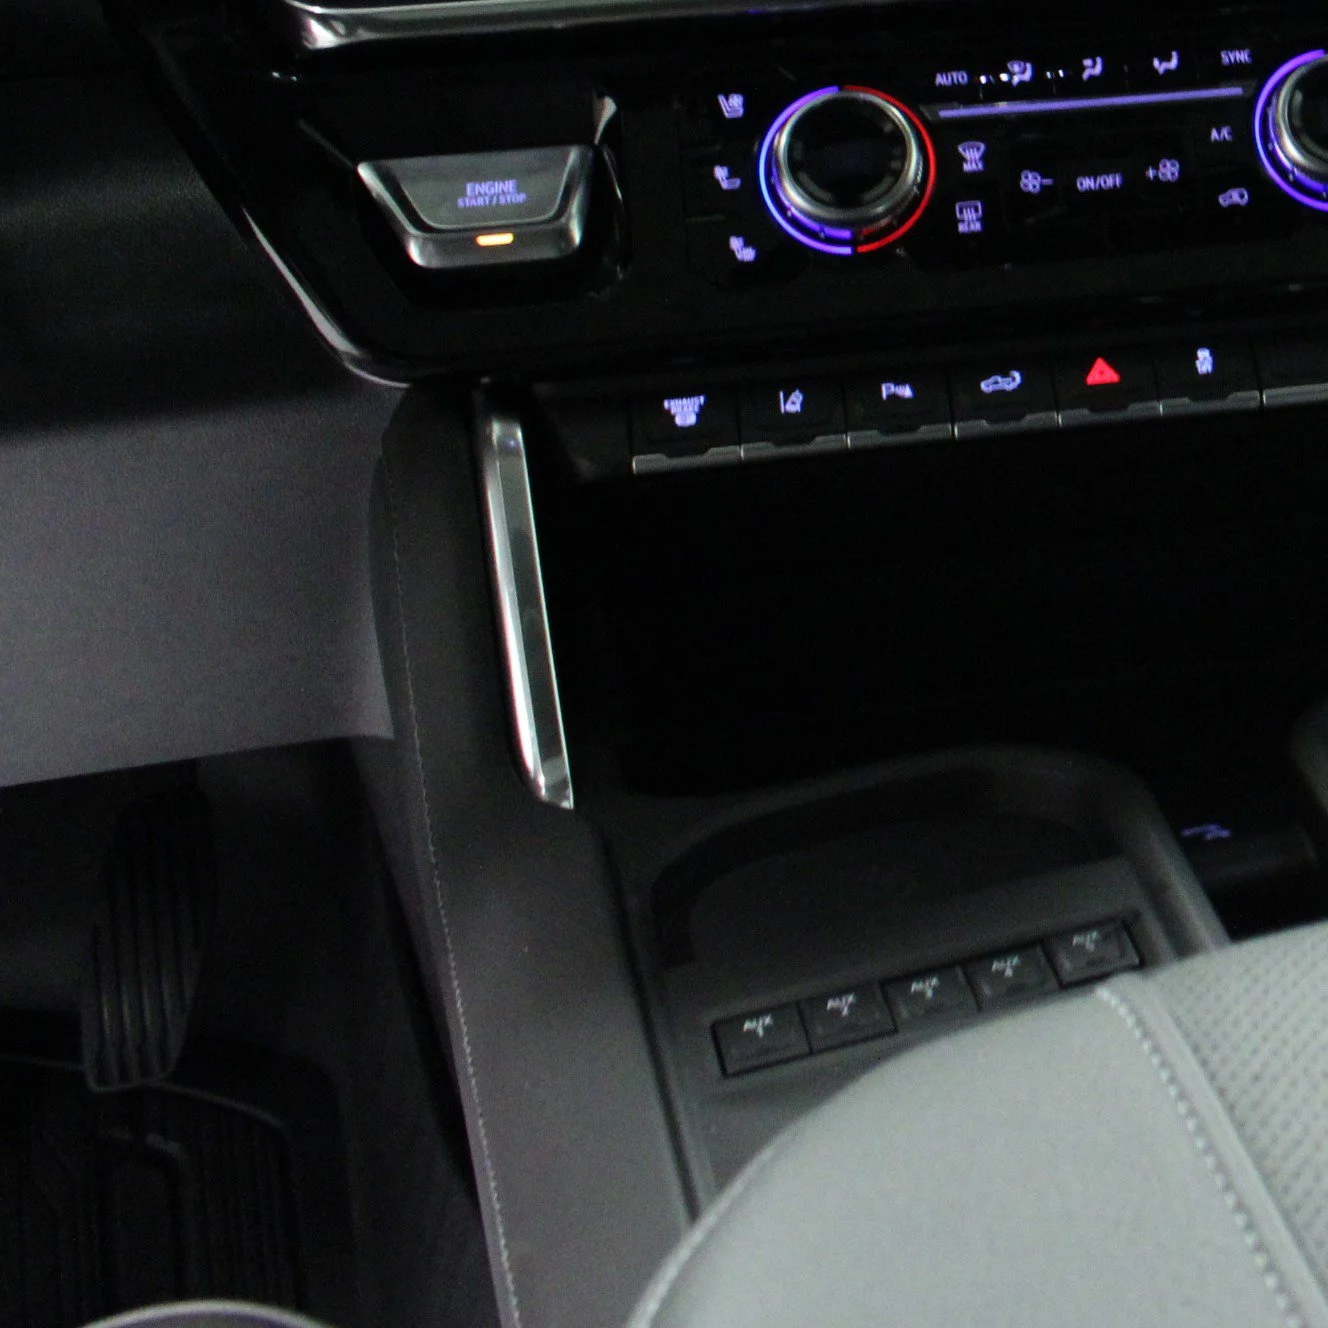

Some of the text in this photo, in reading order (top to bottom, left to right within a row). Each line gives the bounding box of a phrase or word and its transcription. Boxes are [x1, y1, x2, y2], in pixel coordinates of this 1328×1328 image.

[1220, 48, 1253, 65] SYNC
[935, 71, 968, 86] AUTO
[1210, 126, 1232, 142] A/C
[466, 179, 517, 197] ENGINE
[1076, 173, 1123, 193] ON/OFF
